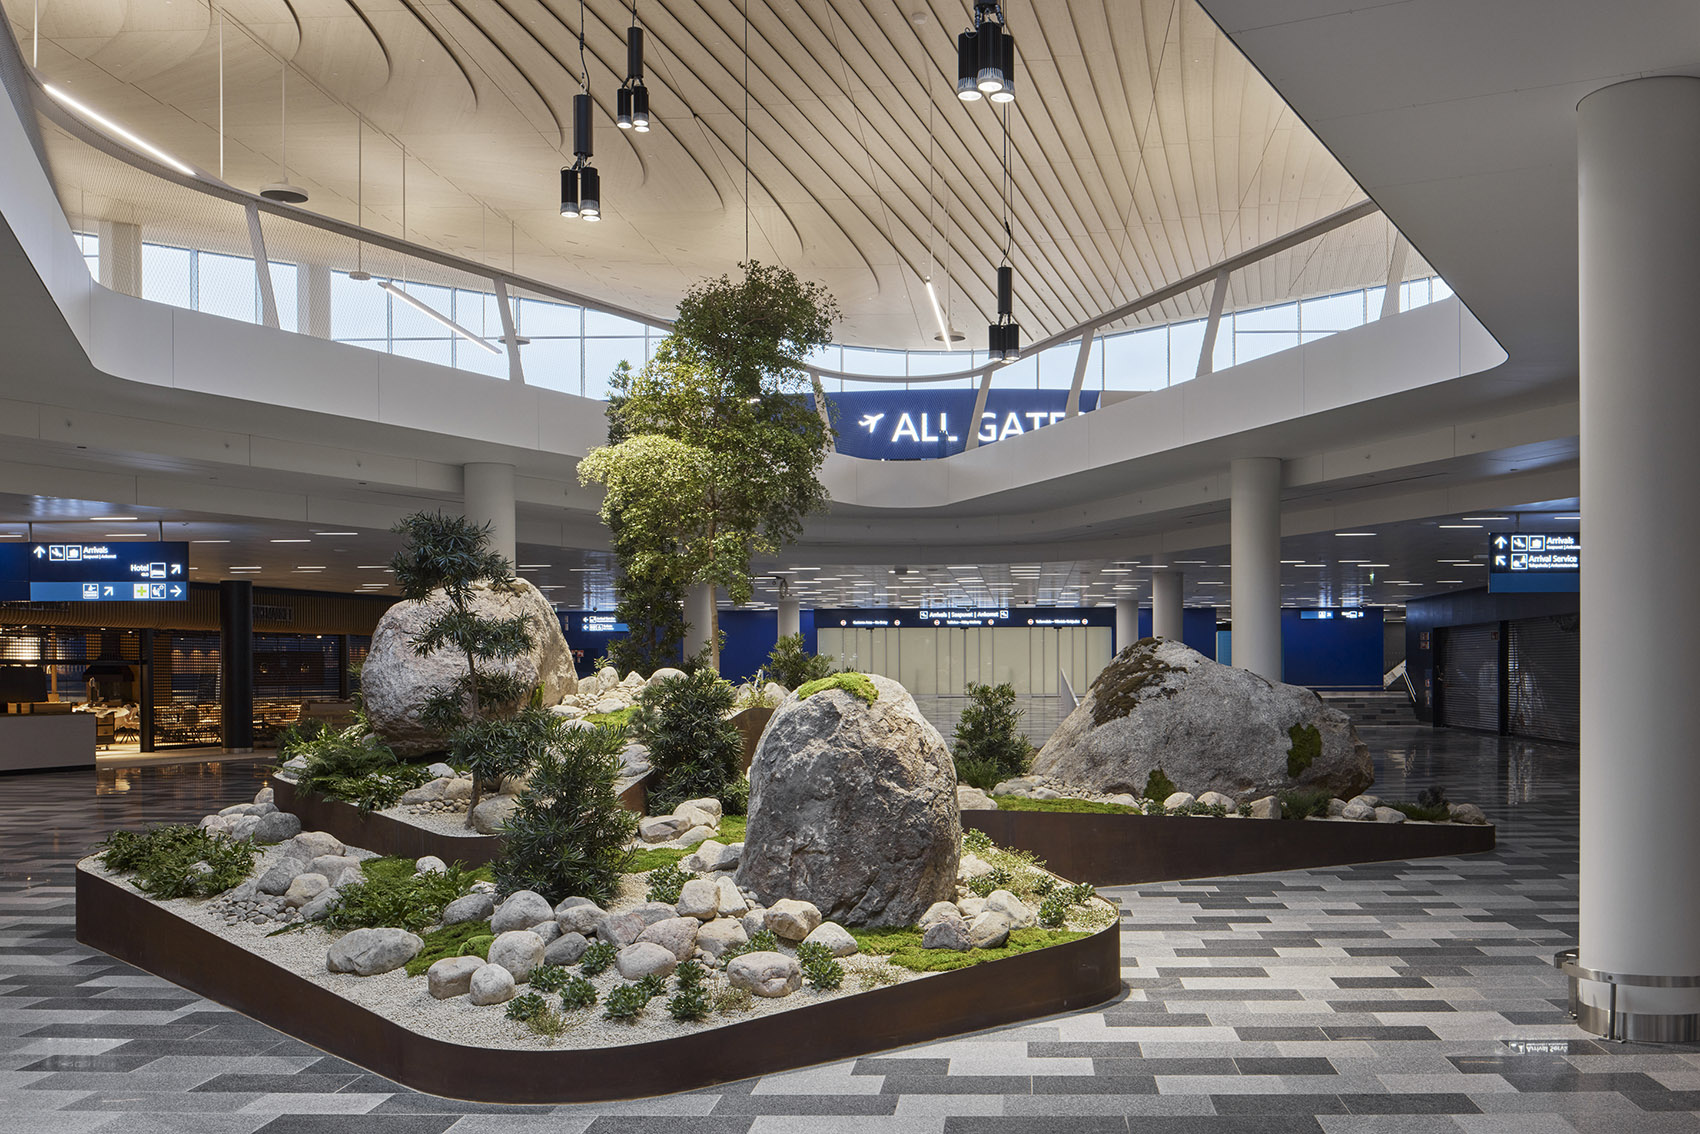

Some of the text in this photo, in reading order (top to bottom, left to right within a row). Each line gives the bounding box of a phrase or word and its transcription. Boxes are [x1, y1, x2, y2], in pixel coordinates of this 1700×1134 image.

[891, 411, 1086, 442] ALL GAT
[1546, 536, 1574, 545] Arrivals
[83, 546, 108, 554] Arrivals
[1528, 554, 1578, 563] Arrival Service
[130, 563, 149, 572] Hotel
